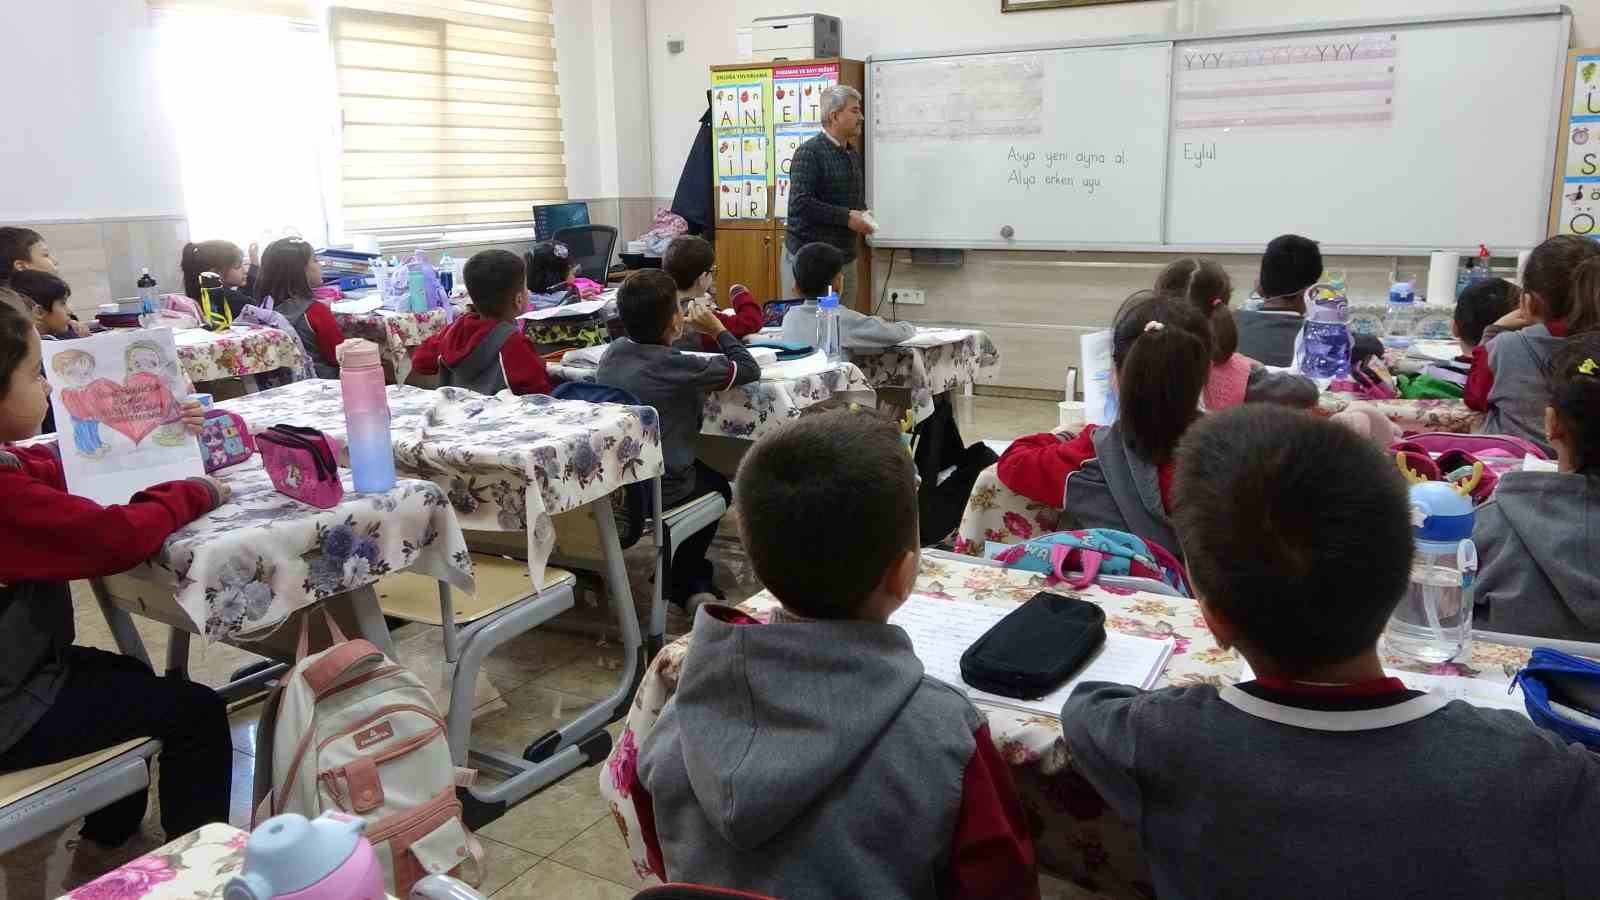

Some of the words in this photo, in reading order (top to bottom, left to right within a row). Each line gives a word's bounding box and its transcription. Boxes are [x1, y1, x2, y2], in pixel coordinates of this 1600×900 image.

[721, 111, 732, 126] A
[745, 109, 756, 125] N
[783, 105, 792, 122] E
[809, 104, 819, 121] T
[750, 159, 760, 175] L
[1581, 153, 1597, 175] S
[727, 201, 738, 217] U
[750, 201, 758, 216] R
[1570, 207, 1595, 235] Ö
